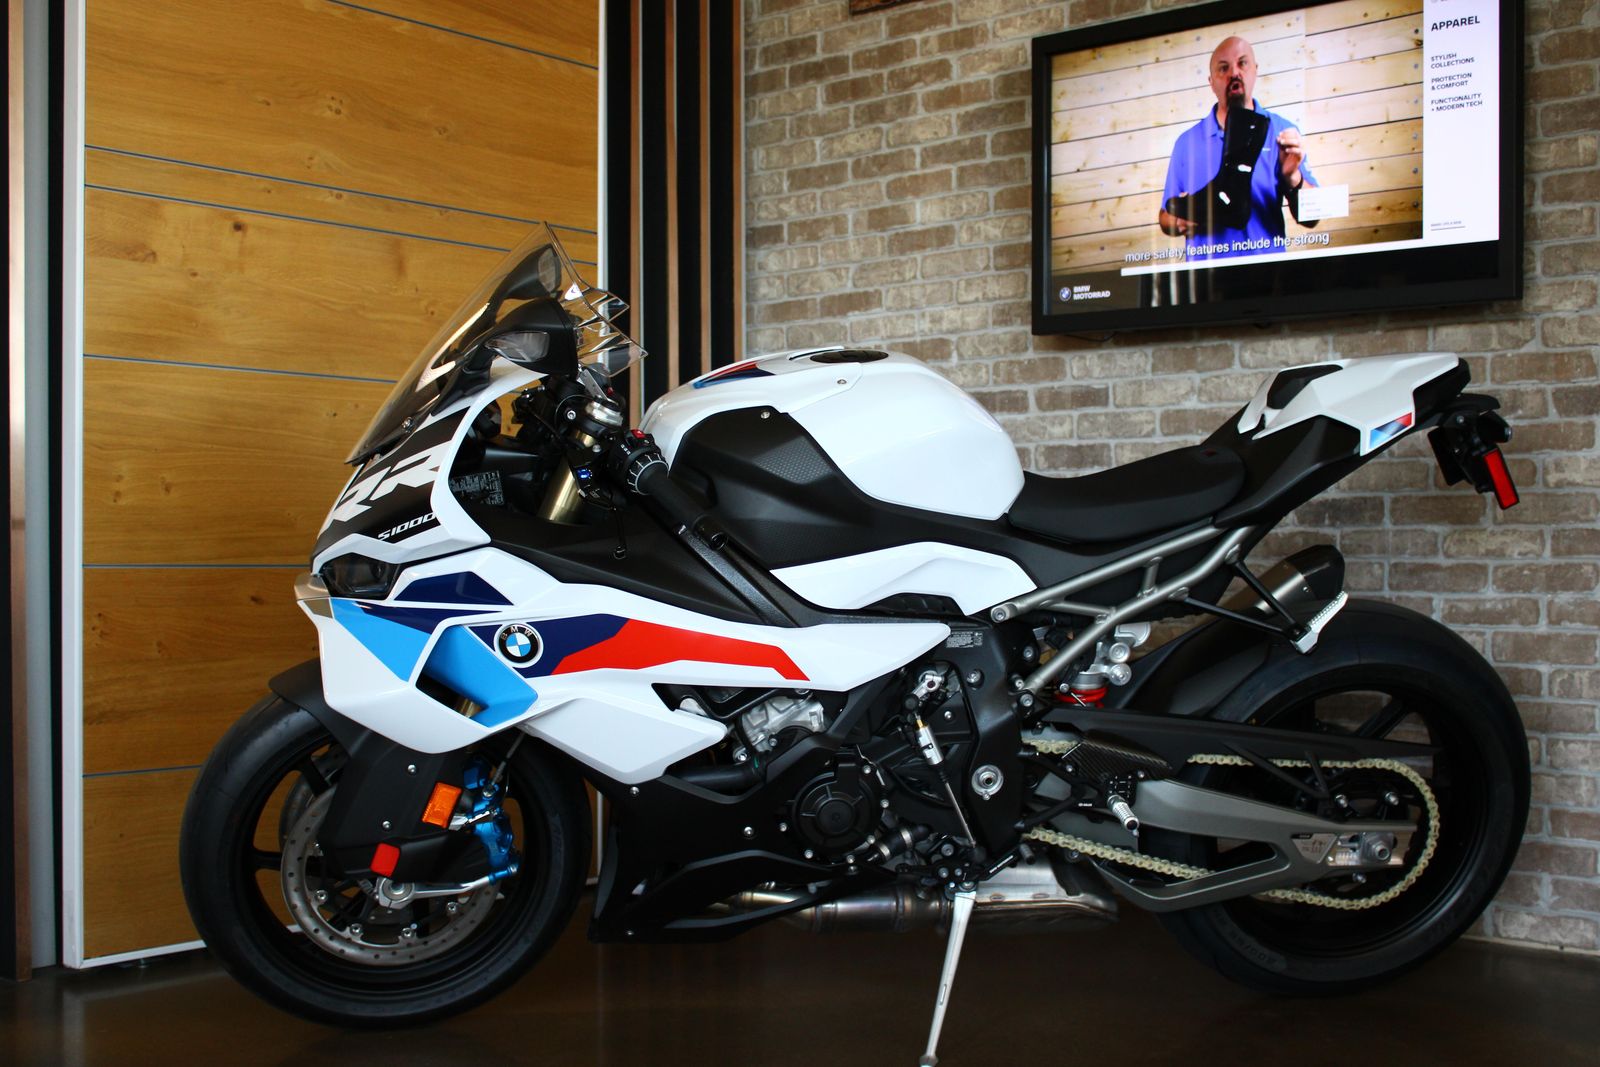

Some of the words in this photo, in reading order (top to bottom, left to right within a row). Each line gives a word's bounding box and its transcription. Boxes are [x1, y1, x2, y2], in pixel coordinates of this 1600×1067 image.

[1431, 15, 1480, 31] APPAREL
[1431, 53, 1457, 62] STYLISH
[1431, 57, 1475, 69] COLLECTIONS
[1431, 72, 1472, 83] PROTECTION
[1436, 80, 1468, 90] COMFORT
[1431, 93, 1481, 105] FUNCTIONALITY
[1436, 103, 1465, 112] MODERN
[1125, 252, 1151, 263] more
[1152, 247, 1185, 262] safety
[1187, 243, 1229, 256] features
[1232, 238, 1270, 252] include
[1274, 235, 1291, 247] the
[1294, 232, 1330, 246] strong
[1073, 285, 1091, 293] BMW
[1073, 290, 1111, 301] MOTORRAD
[500, 625, 533, 641] BMW
